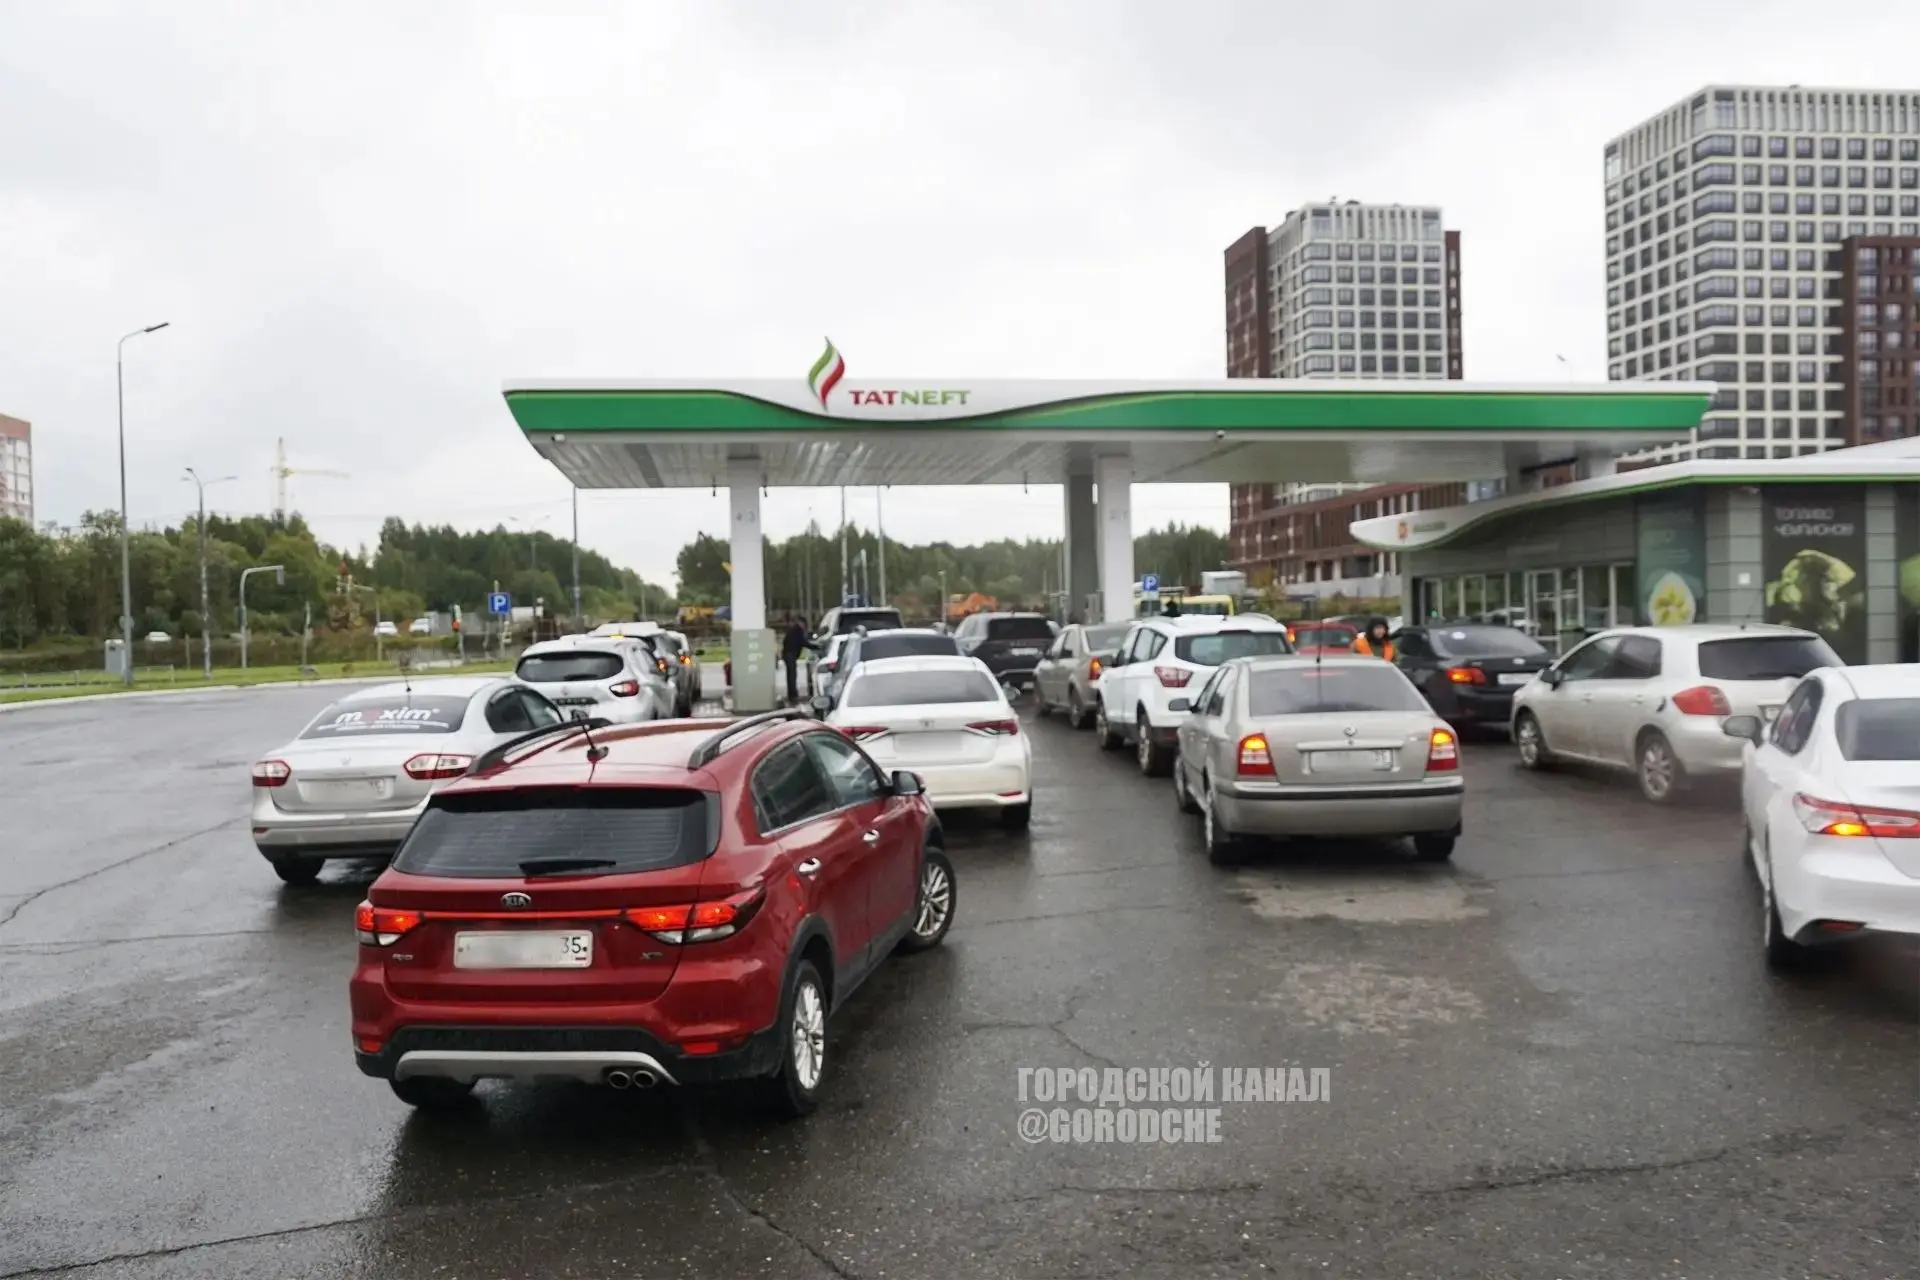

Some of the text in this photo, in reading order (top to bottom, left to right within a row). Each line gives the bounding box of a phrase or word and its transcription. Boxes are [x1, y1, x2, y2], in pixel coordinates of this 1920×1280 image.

[848, 389, 971, 405] TATNEFT
[494, 595, 506, 611] P
[335, 706, 432, 725] mxim
[561, 936, 582, 954] 35
